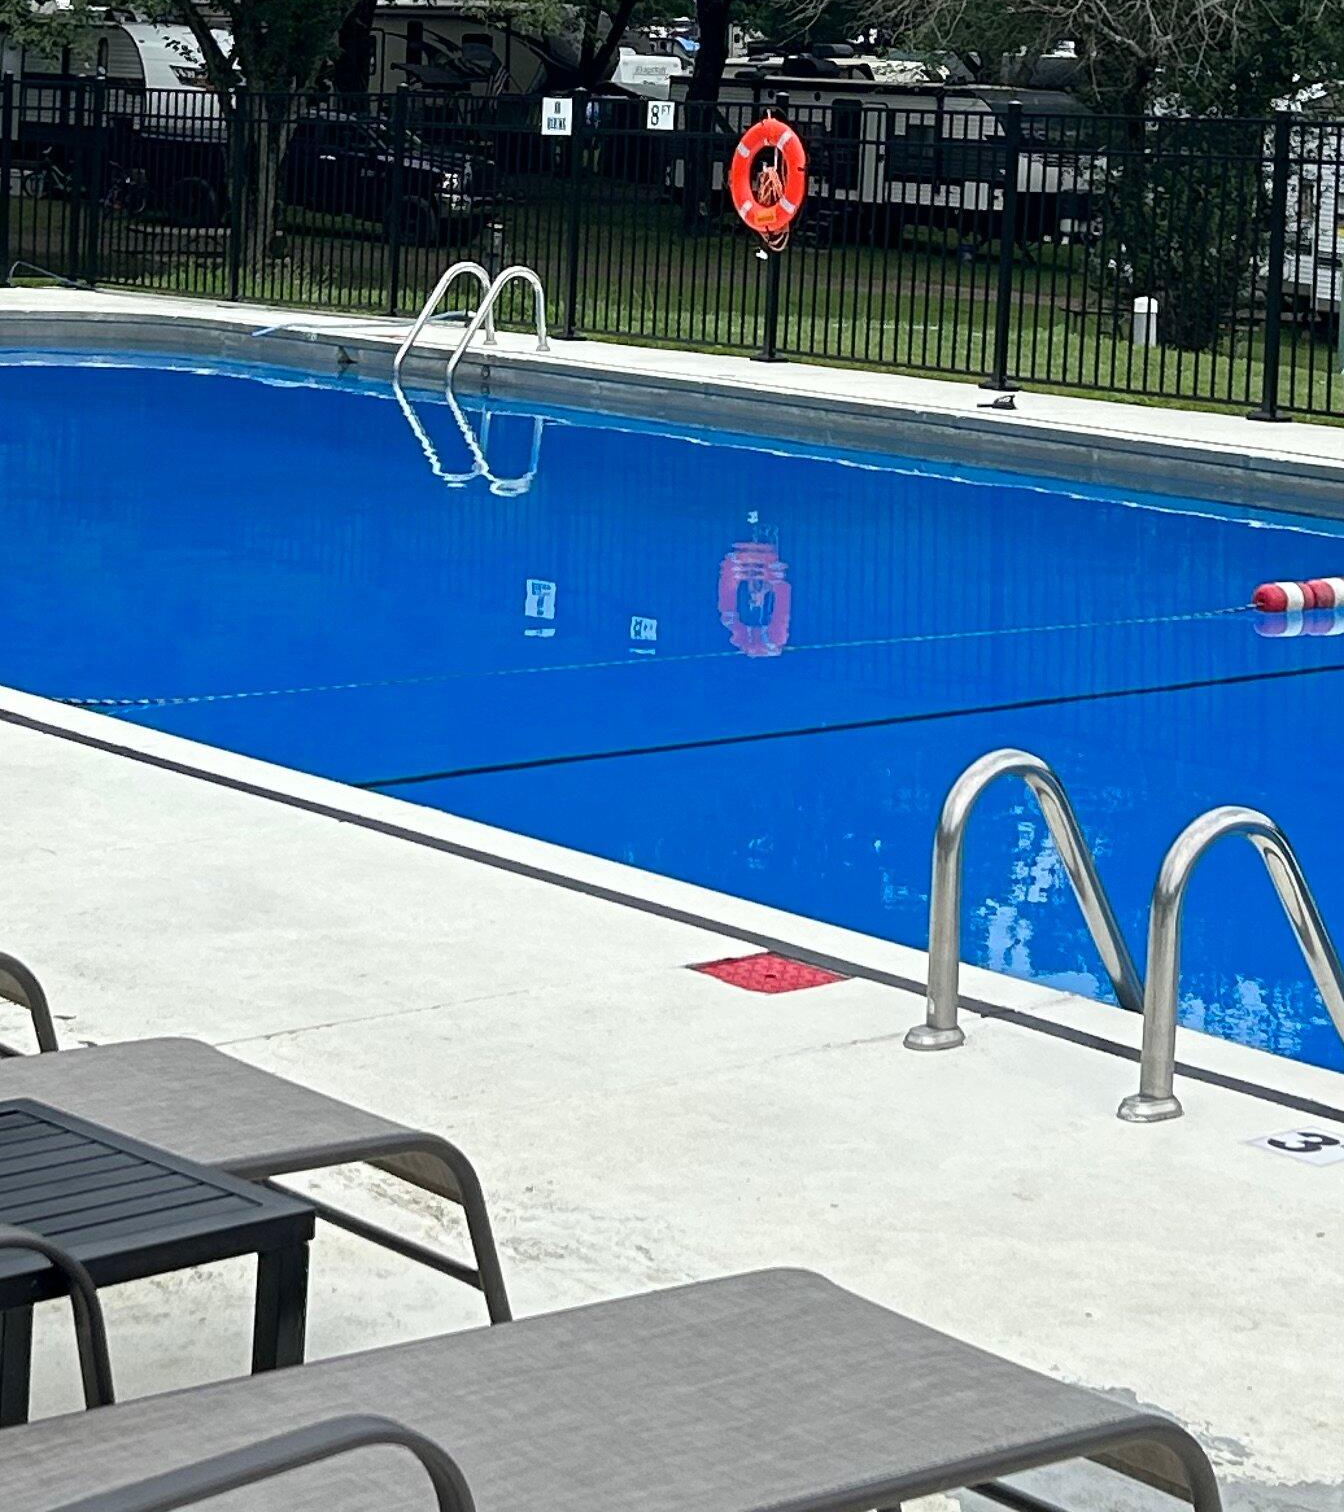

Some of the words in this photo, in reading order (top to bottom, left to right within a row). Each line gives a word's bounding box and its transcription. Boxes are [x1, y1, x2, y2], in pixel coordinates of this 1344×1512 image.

[650, 104, 660, 126] 8
[662, 105, 671, 115] FT
[1267, 1131, 1341, 1153] 3
